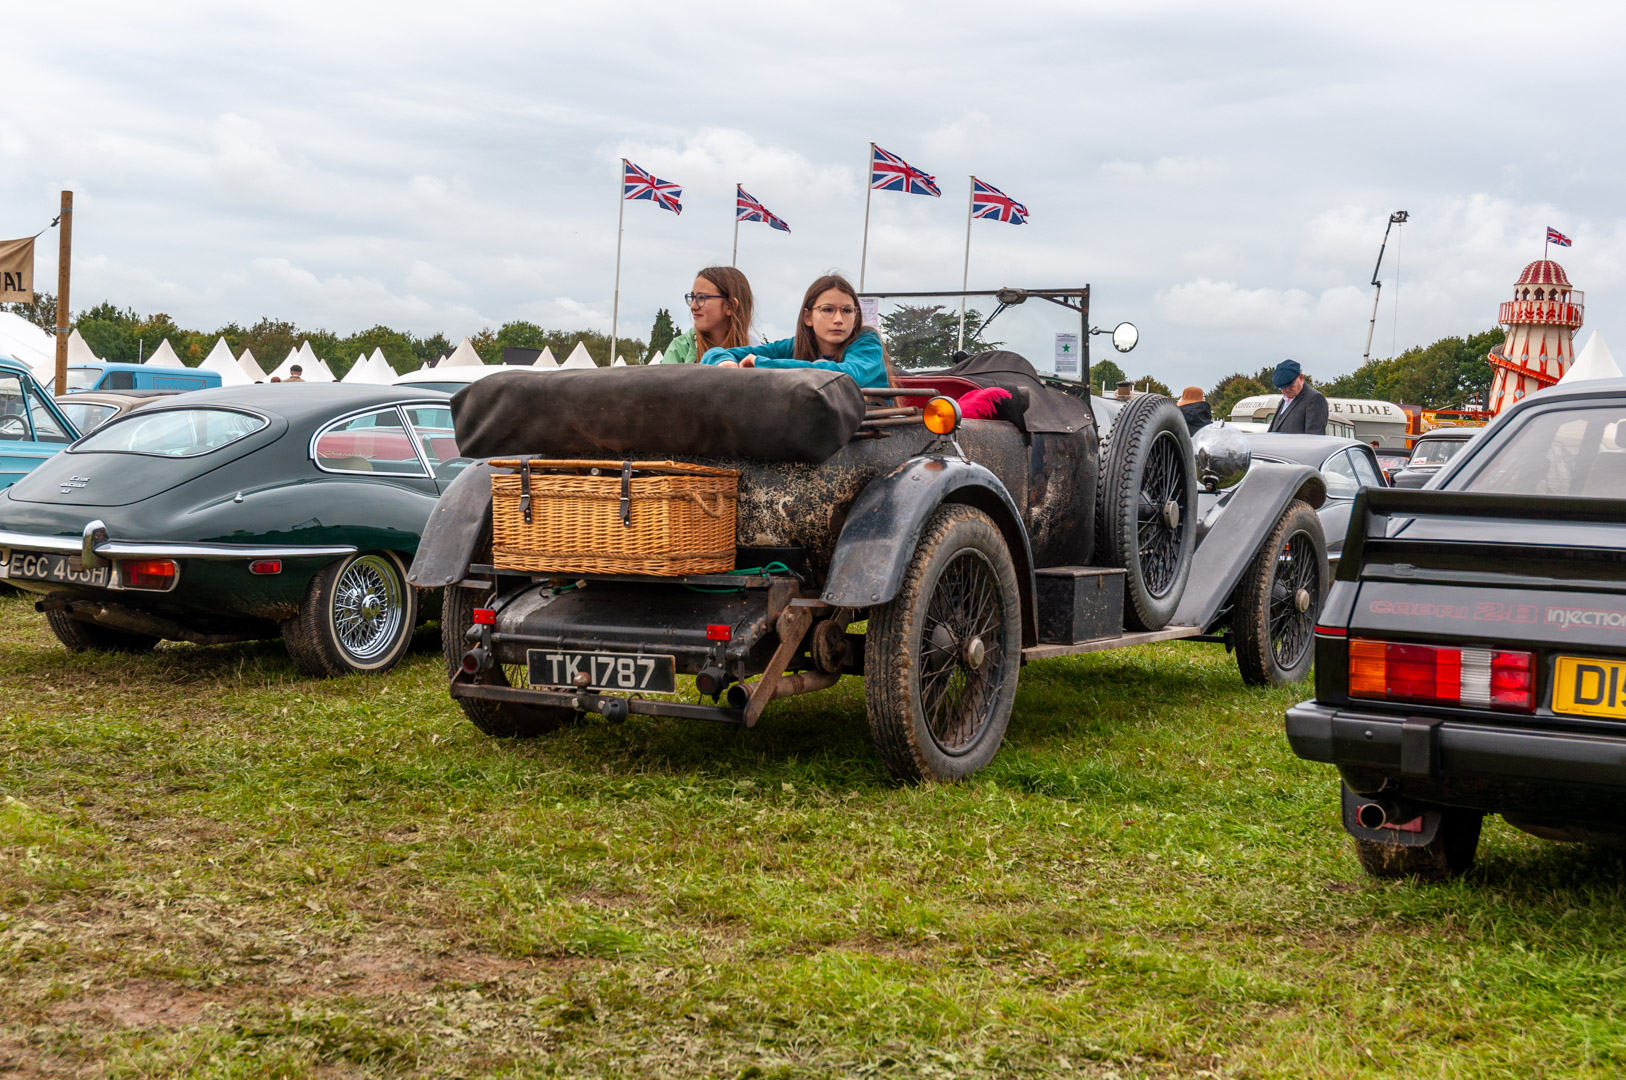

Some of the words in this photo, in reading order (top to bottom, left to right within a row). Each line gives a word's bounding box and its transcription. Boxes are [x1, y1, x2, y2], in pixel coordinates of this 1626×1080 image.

[0, 271, 26, 292] AL
[1346, 403, 1393, 416] TIME
[10, 553, 49, 578] EGC
[546, 654, 582, 684] TK
[590, 656, 656, 689] 1787
[1574, 664, 1626, 707] D1
